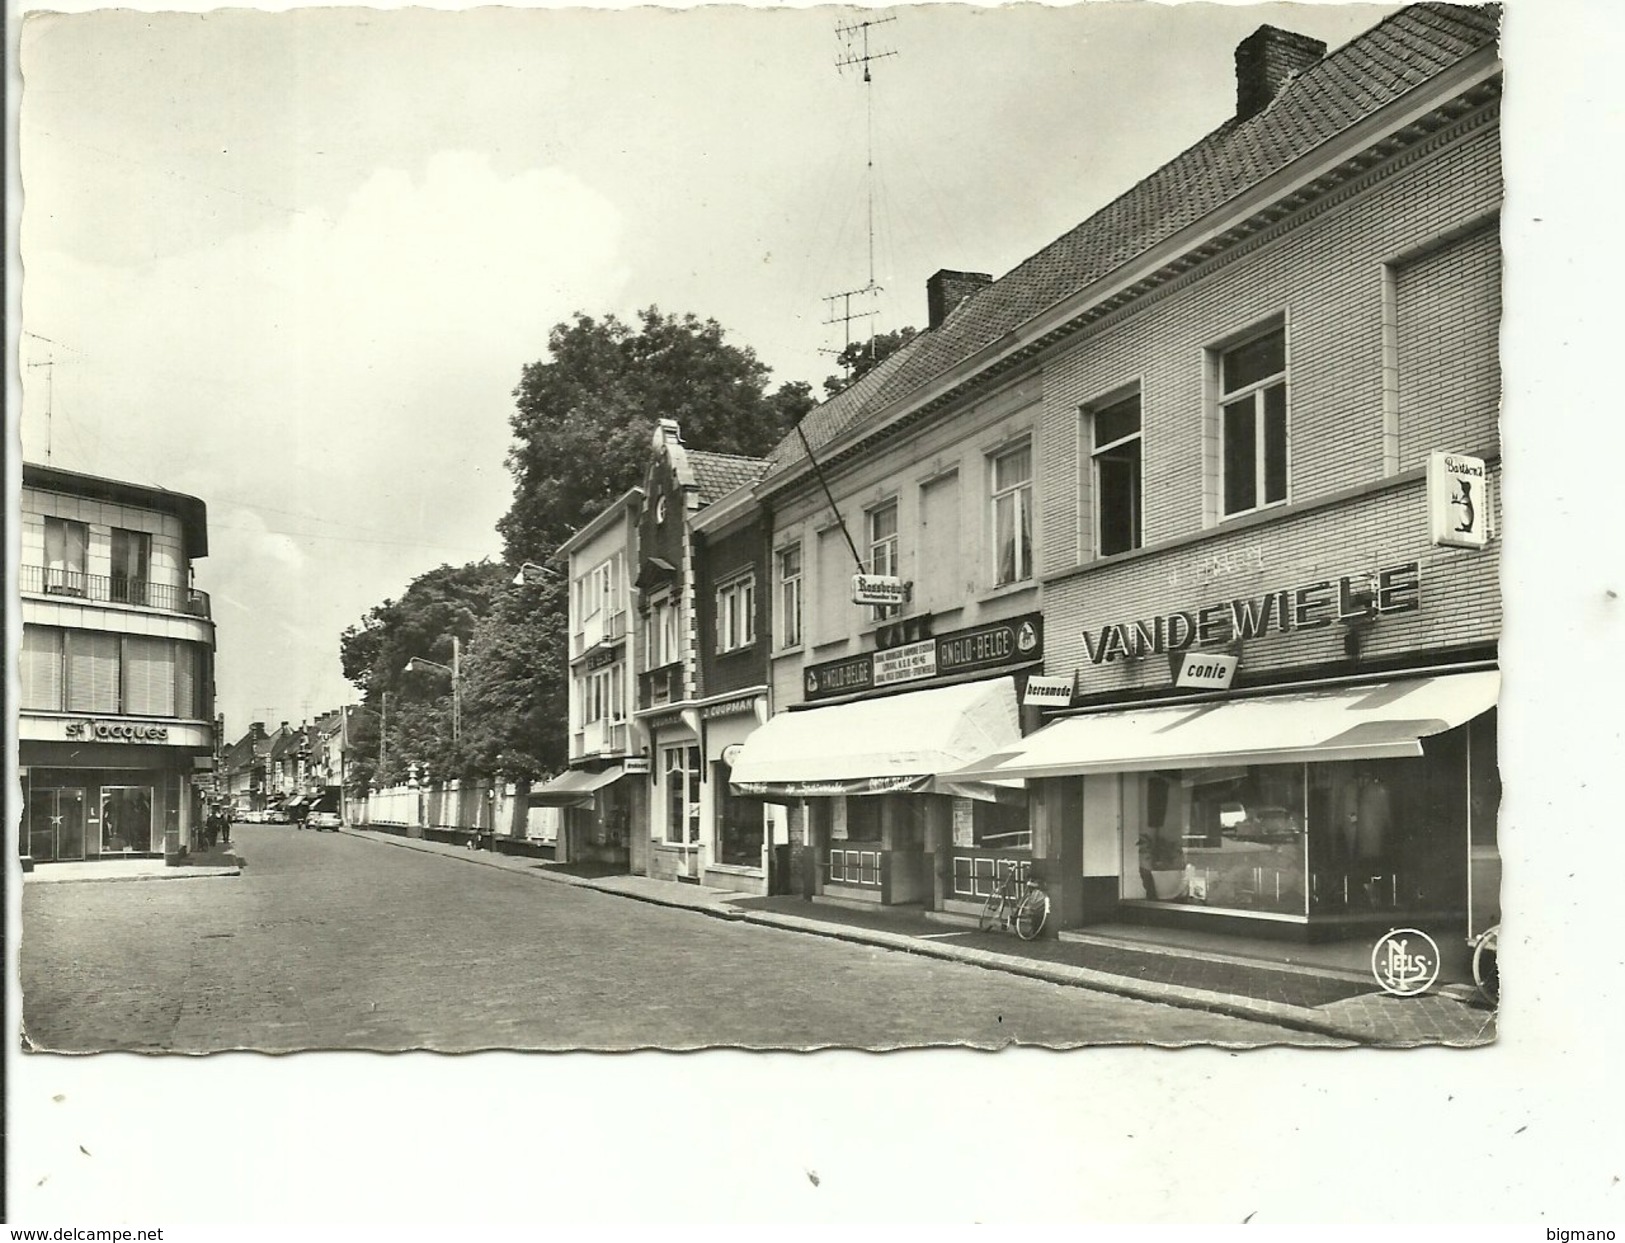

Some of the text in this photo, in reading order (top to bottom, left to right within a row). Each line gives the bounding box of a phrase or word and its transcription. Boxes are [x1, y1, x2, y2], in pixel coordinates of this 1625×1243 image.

[1082, 559, 1421, 664] VANDEWIELE
[1187, 662, 1226, 679] conie
[1027, 683, 1071, 697] herenmode
